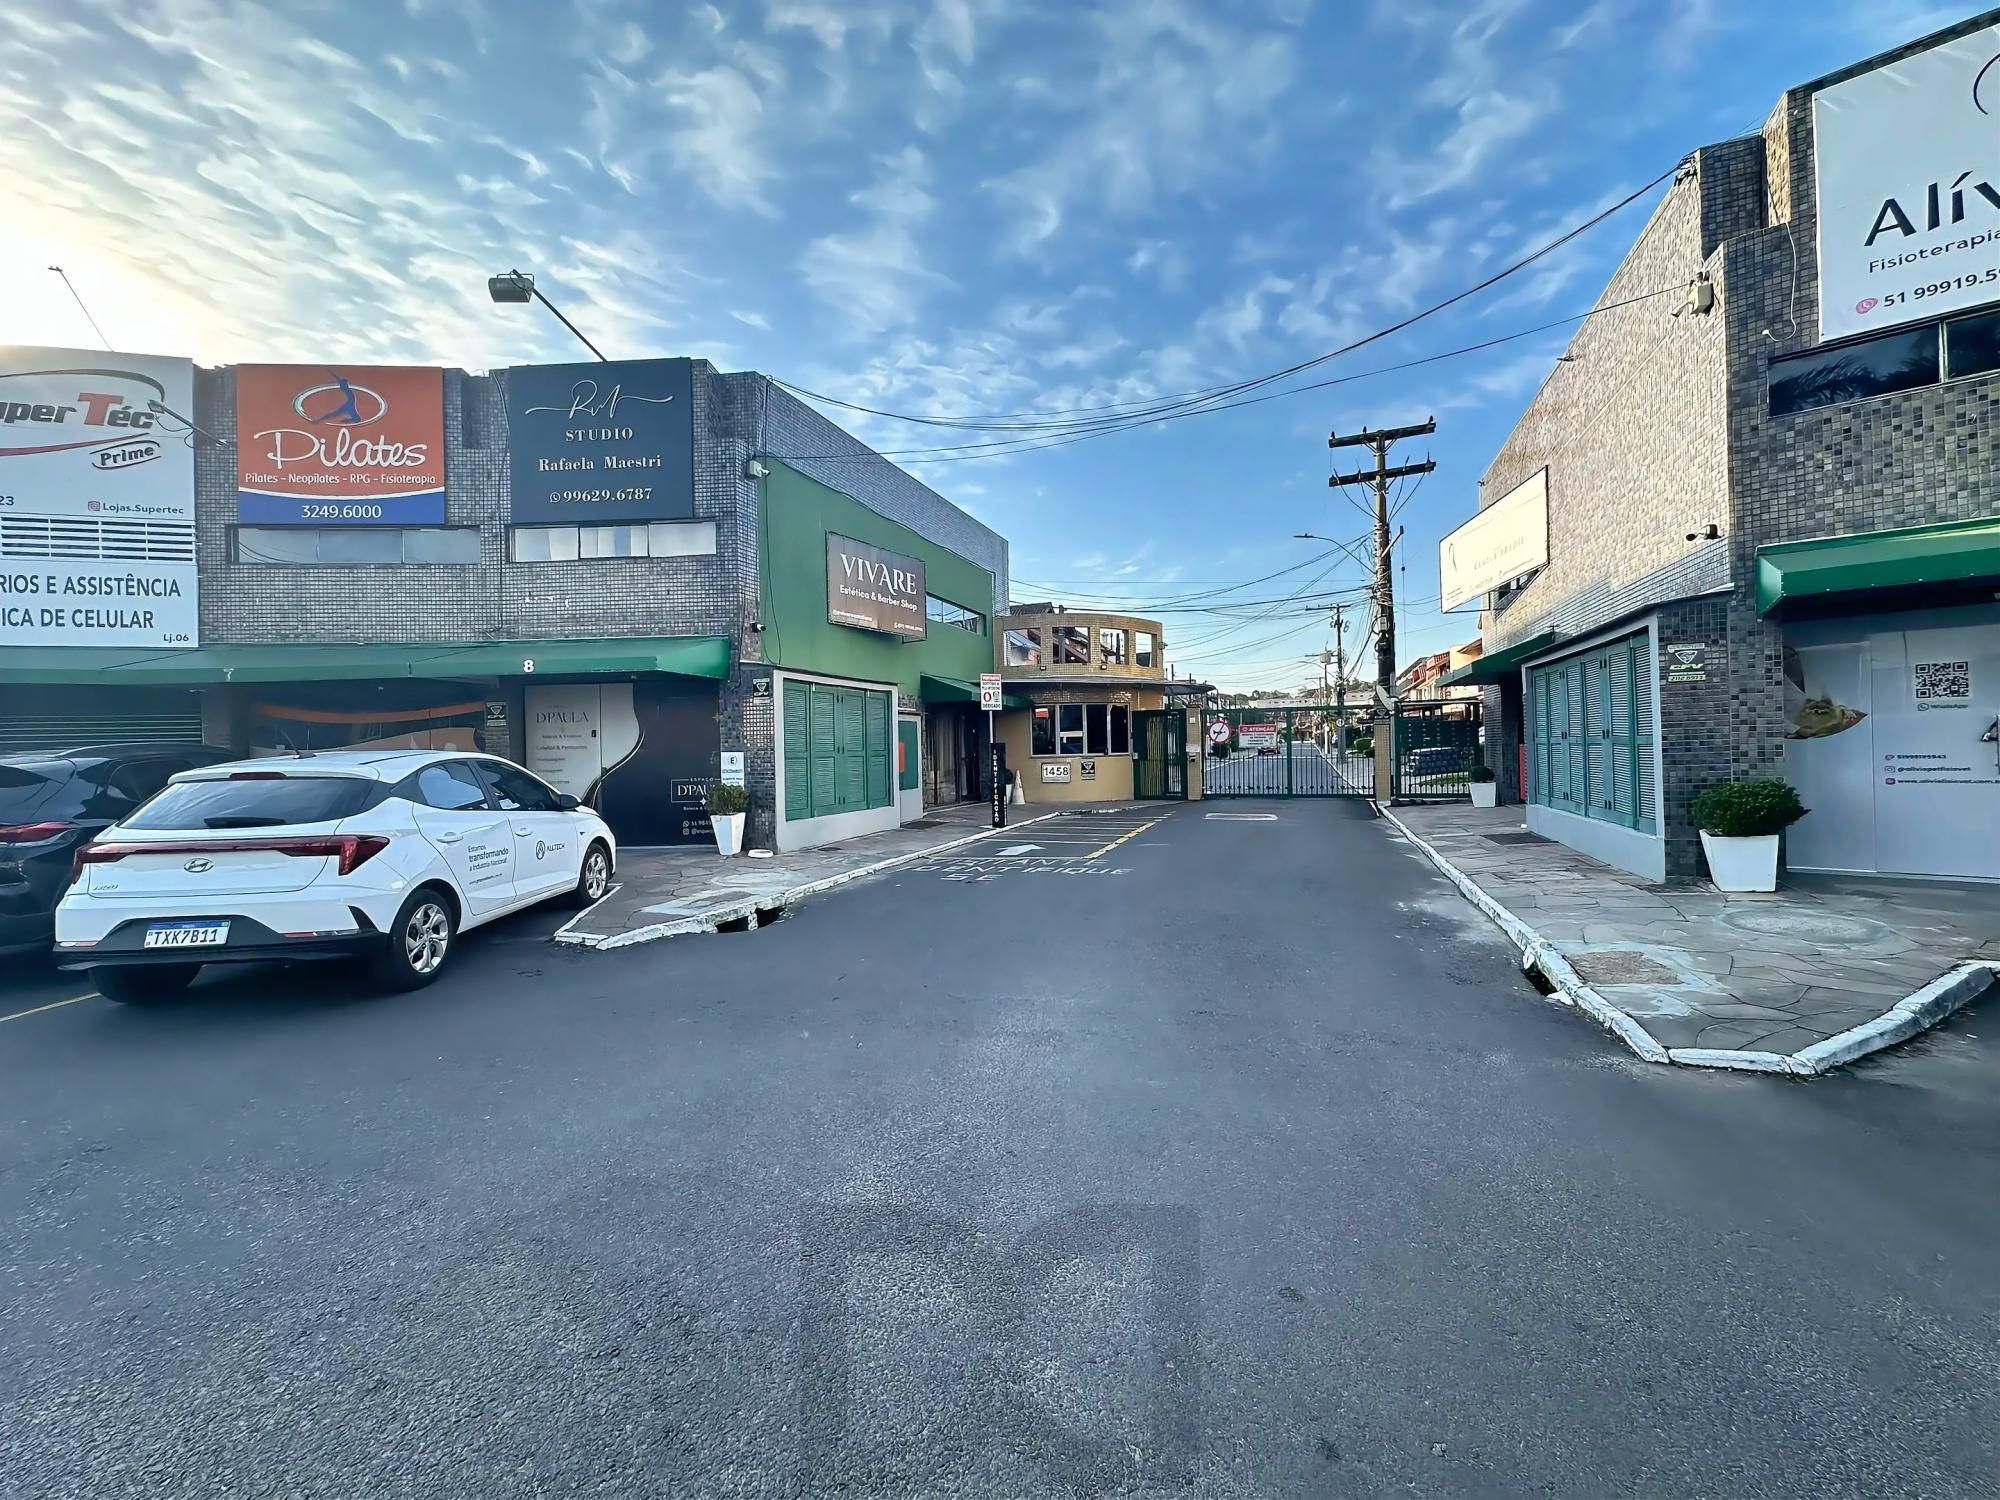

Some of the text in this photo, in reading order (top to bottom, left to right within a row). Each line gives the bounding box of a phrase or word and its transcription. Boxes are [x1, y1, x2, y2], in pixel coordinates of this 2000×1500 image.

[1883, 268, 2000, 307] 51 99919.5
[565, 427, 633, 442] STUDIO
[253, 428, 427, 469] Pilates
[100, 447, 154, 466] Prime
[538, 455, 662, 472] Rafaela Maestri
[245, 473, 278, 483] Pilates
[288, 473, 340, 485] Neopilates
[349, 474, 371, 484] RPG
[381, 474, 436, 485] Fisioterapia
[563, 488, 652, 502] 99629.6787
[103, 503, 184, 514] Lojas.Supertec
[301, 505, 382, 518] 3249.6000
[840, 553, 917, 595] VIVARE
[46, 576, 57, 594] E
[63, 573, 181, 597] ASSISTÊNCIA
[840, 584, 917, 613] Estética & Barber Shop
[2, 608, 154, 629] ICA DE CELULAR
[163, 633, 189, 643] Lj.06
[523, 659, 535, 673] 8
[223, 668, 235, 682] 7
[730, 757, 735, 765] E
[1044, 766, 1069, 776] 1458
[469, 847, 509, 863] transformando
[940, 873, 1003, 881] SE
[154, 929, 218, 945] TXK7B11
